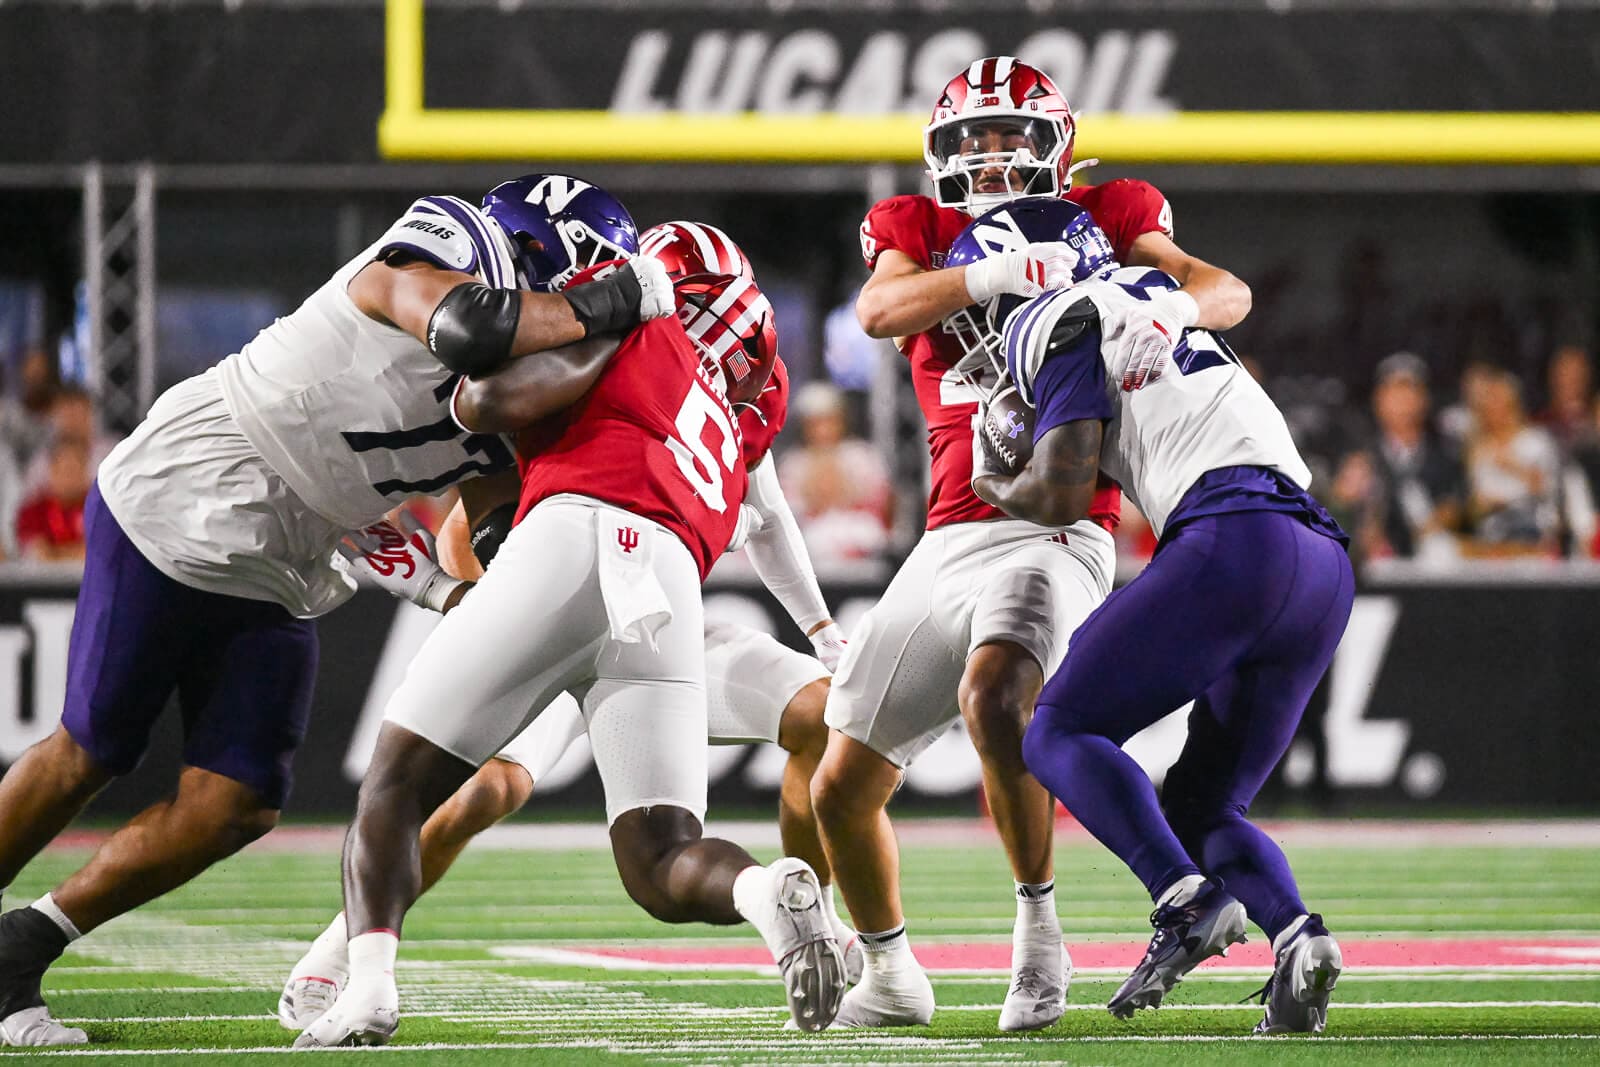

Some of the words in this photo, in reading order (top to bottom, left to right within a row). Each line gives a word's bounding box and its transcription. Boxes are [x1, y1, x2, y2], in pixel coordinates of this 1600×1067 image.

[607, 28, 985, 113] LUCAS
[1014, 28, 1178, 113] OIL
[674, 379, 740, 515] 5
